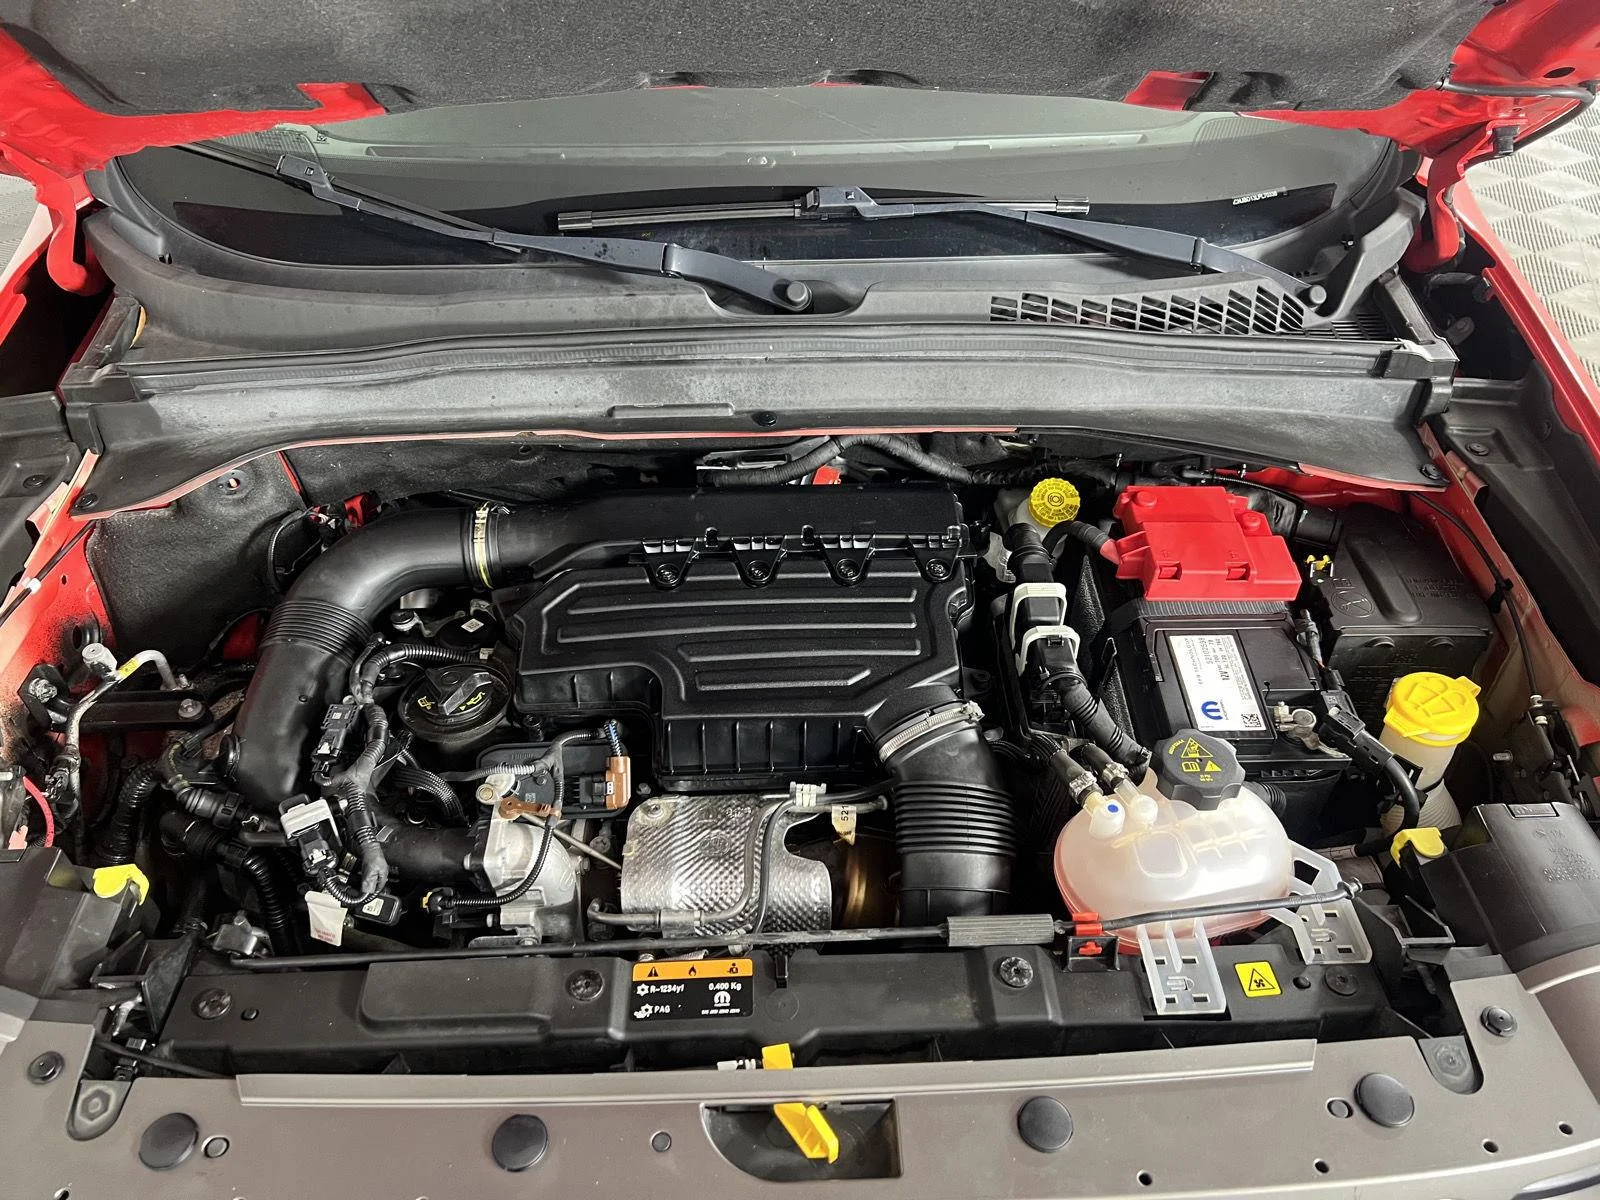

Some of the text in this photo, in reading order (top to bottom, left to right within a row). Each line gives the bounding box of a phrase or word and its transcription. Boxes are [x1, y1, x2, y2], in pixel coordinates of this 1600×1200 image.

[841, 805, 849, 821] 521
[708, 982, 742, 991] 0.400 Kg
[654, 1005, 670, 1013] PAG
